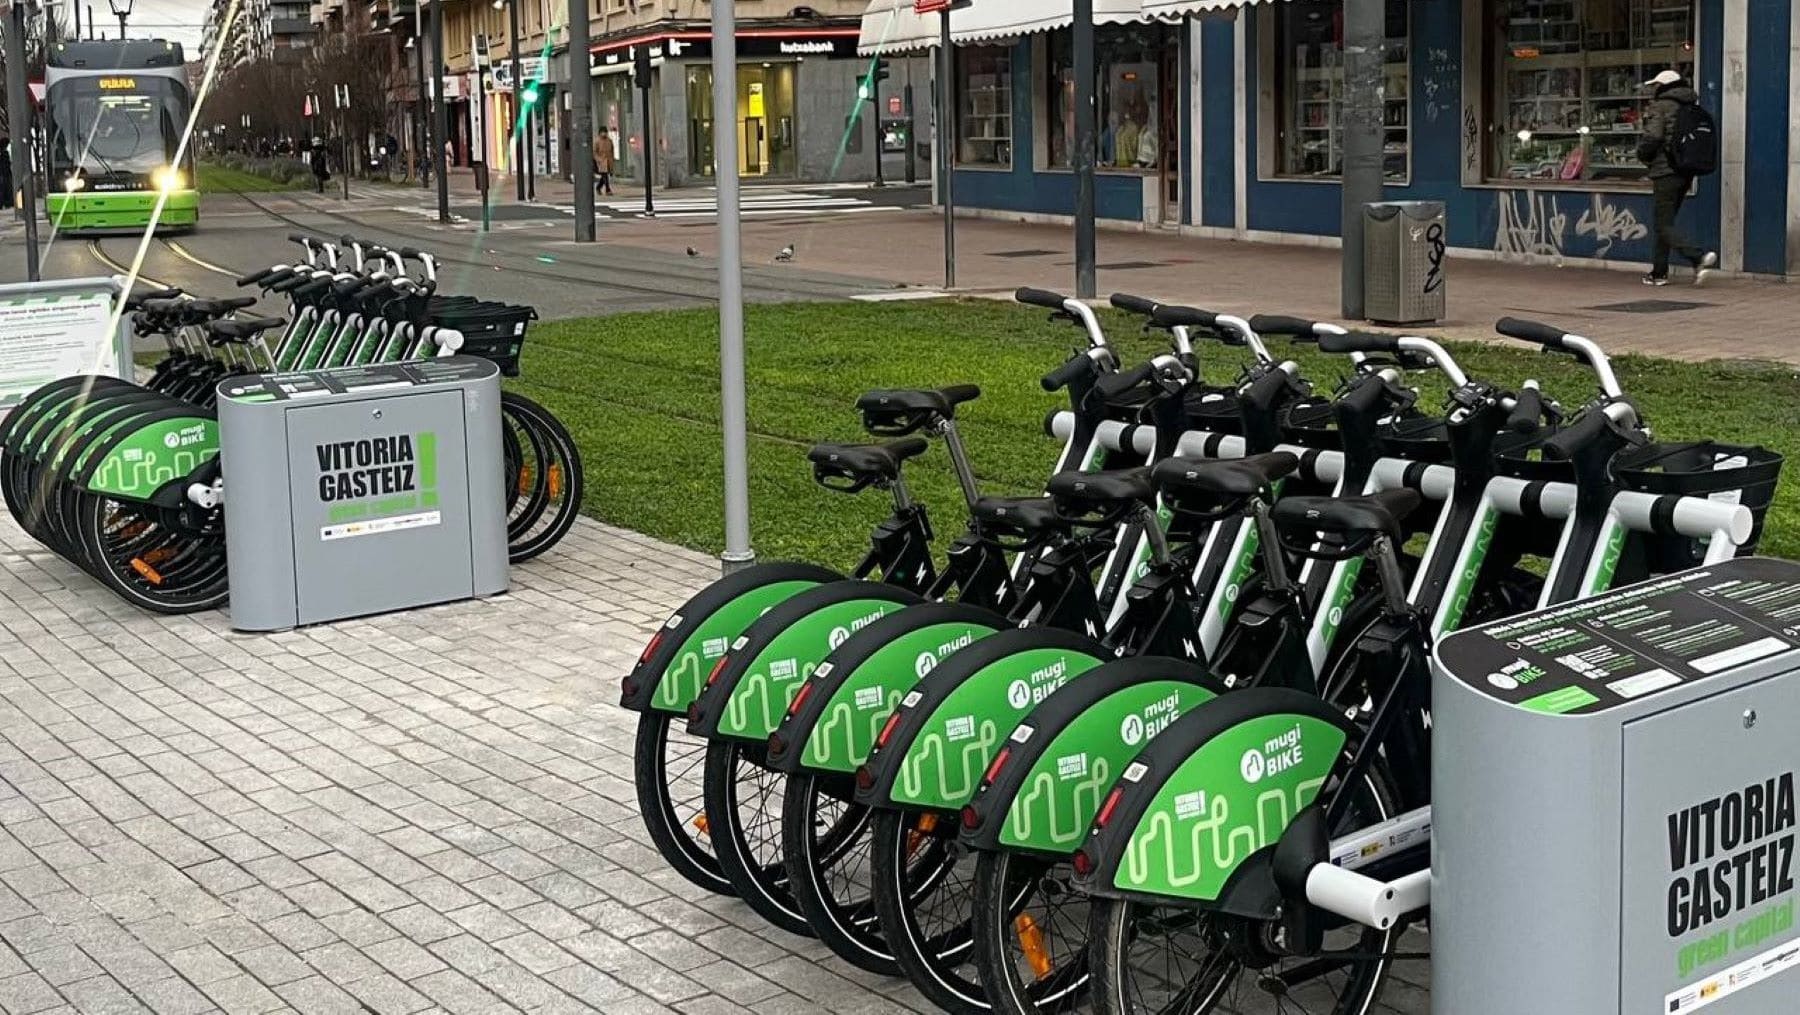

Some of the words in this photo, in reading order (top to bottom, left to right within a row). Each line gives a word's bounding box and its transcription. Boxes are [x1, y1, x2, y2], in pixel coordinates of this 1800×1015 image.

[316, 434, 414, 472] VITORIA
[319, 464, 415, 502] GASTEIZ
[1031, 656, 1067, 684] mugi
[1144, 689, 1179, 719] mugi
[1264, 723, 1301, 754] mugi
[1266, 745, 1304, 777] BIKE
[1667, 772, 1796, 871] VITORIA
[1667, 833, 1795, 938] GASTEIZ
